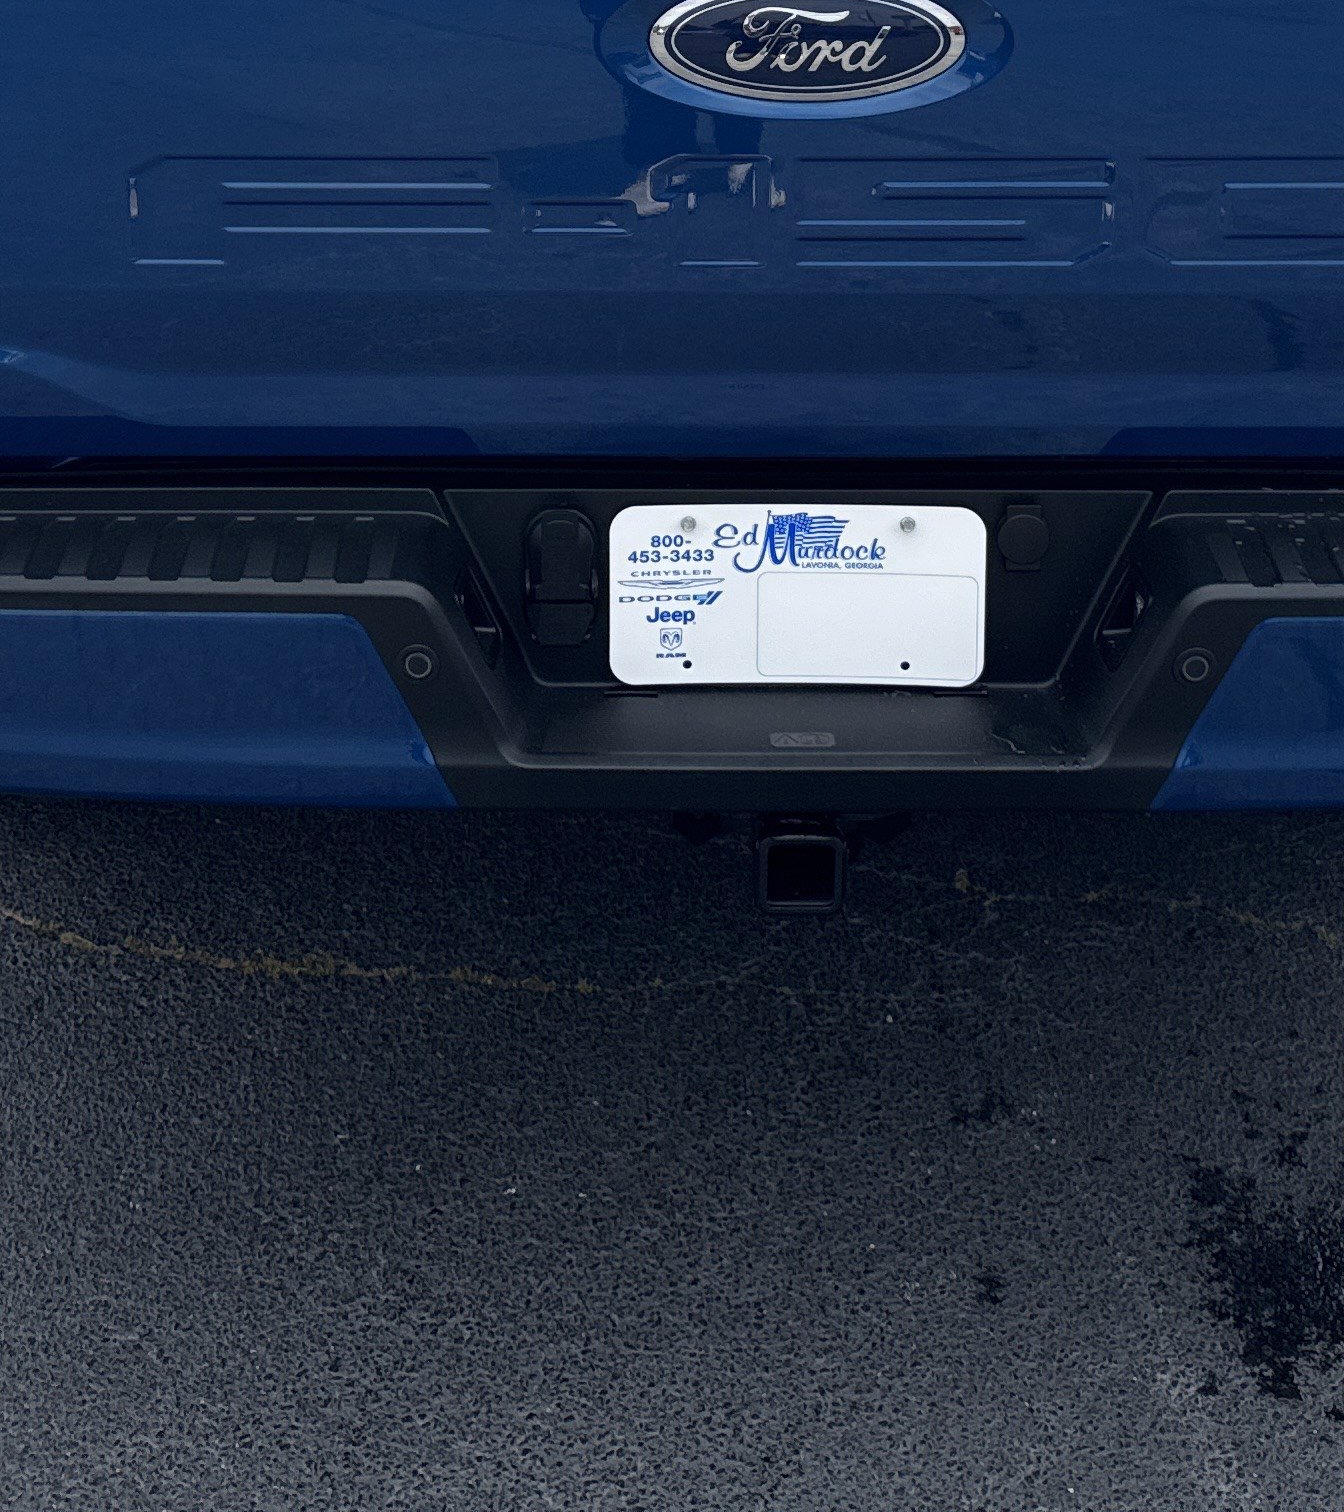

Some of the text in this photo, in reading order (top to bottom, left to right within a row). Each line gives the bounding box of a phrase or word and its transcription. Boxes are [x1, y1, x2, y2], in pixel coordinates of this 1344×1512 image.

[724, 5, 892, 72] Ford
[650, 534, 692, 548] 800-
[712, 522, 886, 573] Ed Murdock
[627, 548, 714, 564] 453-3433
[844, 561, 884, 570] GEORGIA
[630, 569, 712, 578] CHRYSLER
[618, 593, 709, 603] DODGE
[646, 606, 696, 625] Jeep
